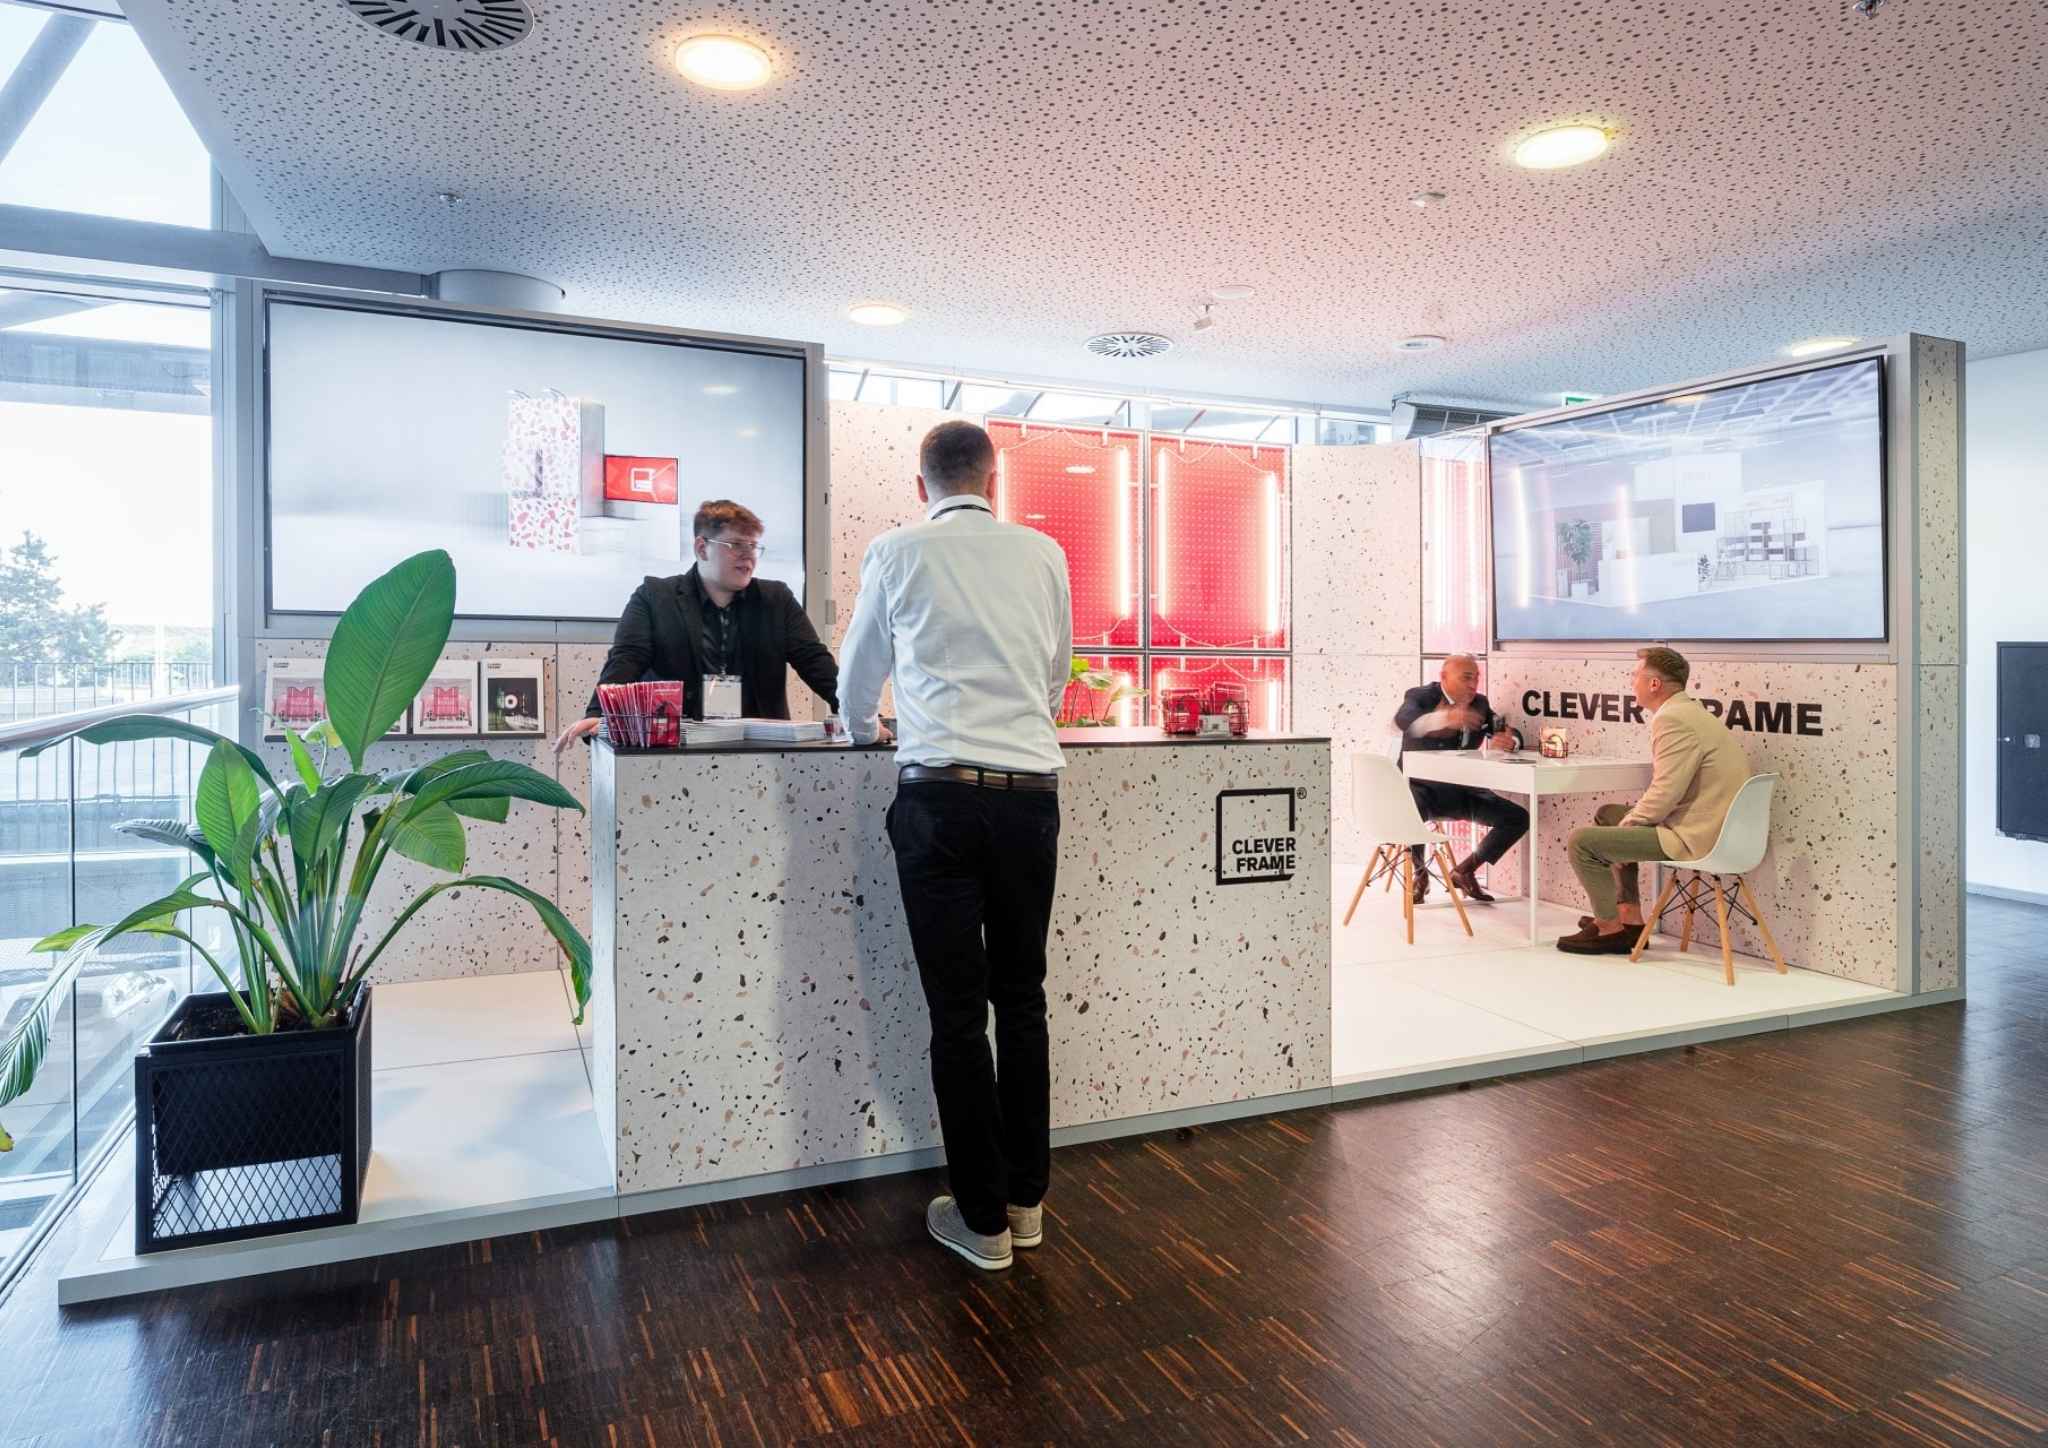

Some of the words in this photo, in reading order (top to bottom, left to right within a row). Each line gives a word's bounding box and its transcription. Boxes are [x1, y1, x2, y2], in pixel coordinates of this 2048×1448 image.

[1522, 690, 1645, 724] CLEVER
[1690, 698, 1823, 736] AME
[1232, 837, 1296, 854] CLEVER
[1236, 855, 1296, 873] FRAME
